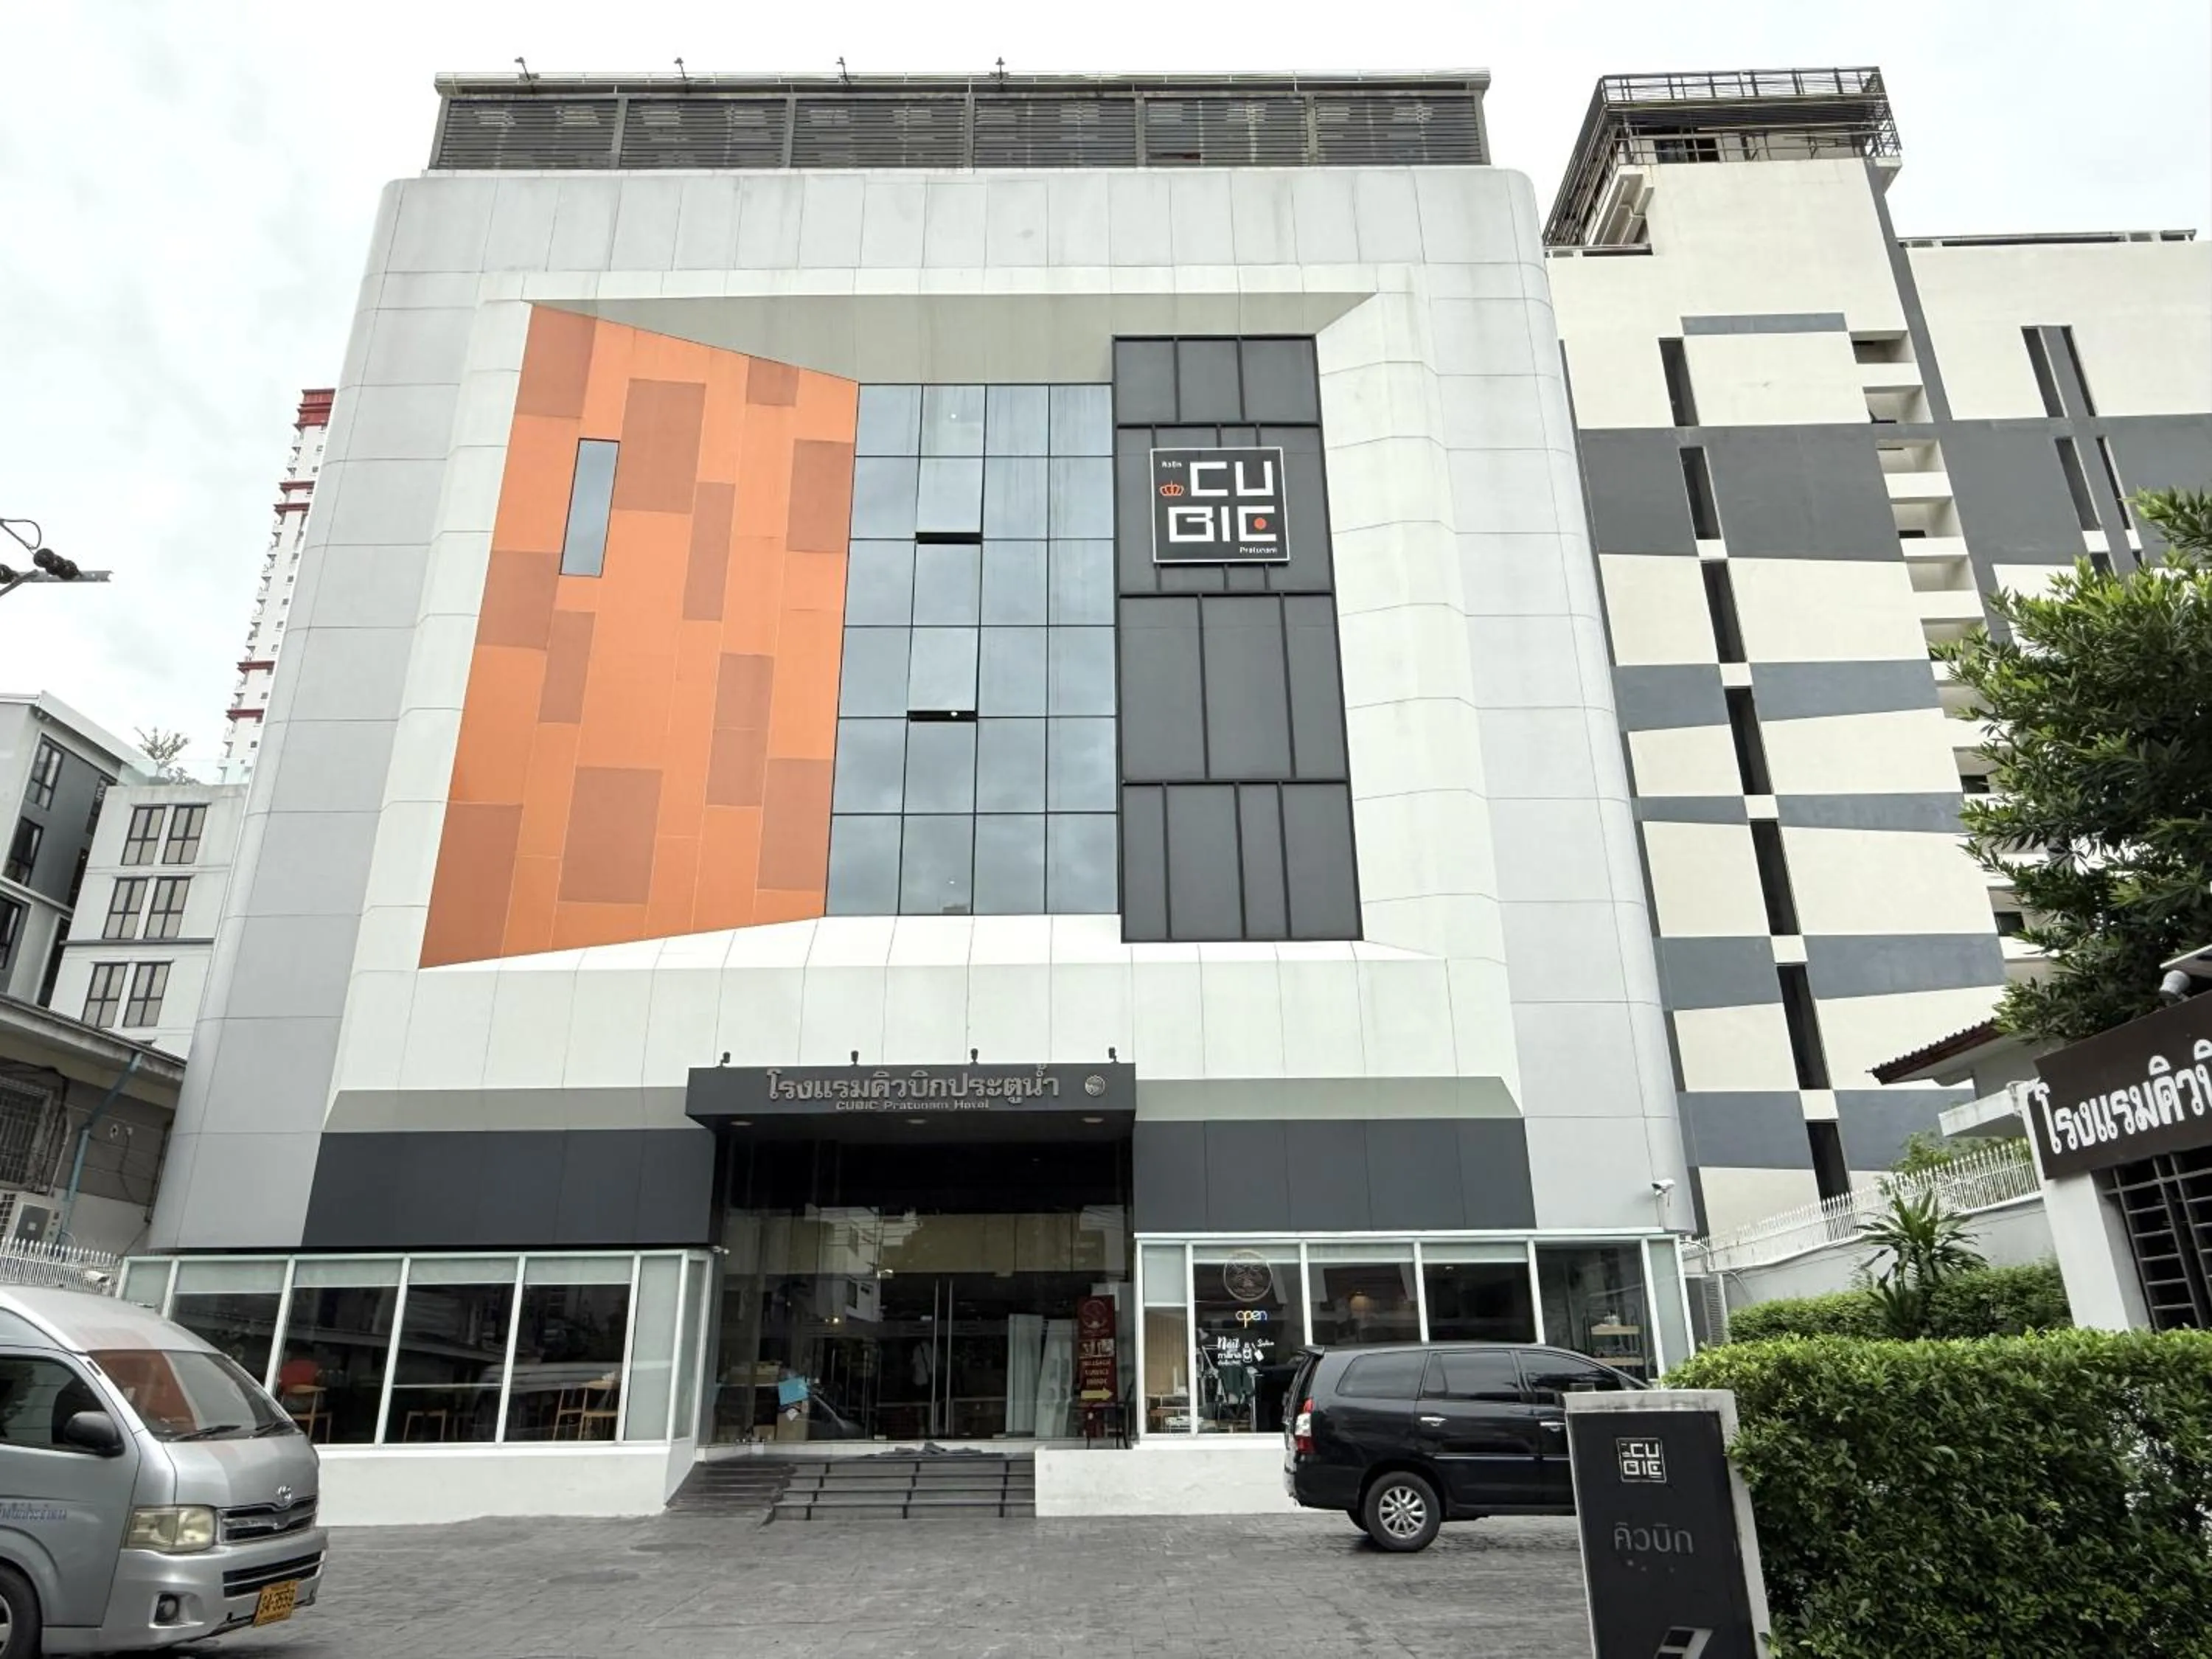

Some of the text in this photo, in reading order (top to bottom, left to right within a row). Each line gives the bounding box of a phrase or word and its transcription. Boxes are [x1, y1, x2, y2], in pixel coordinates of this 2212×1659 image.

[1189, 461, 1274, 496] CU
[766, 1063, 1060, 1104] โรงแรมคิวบิกประตูน้ำ
[1236, 1310, 1267, 1328] open
